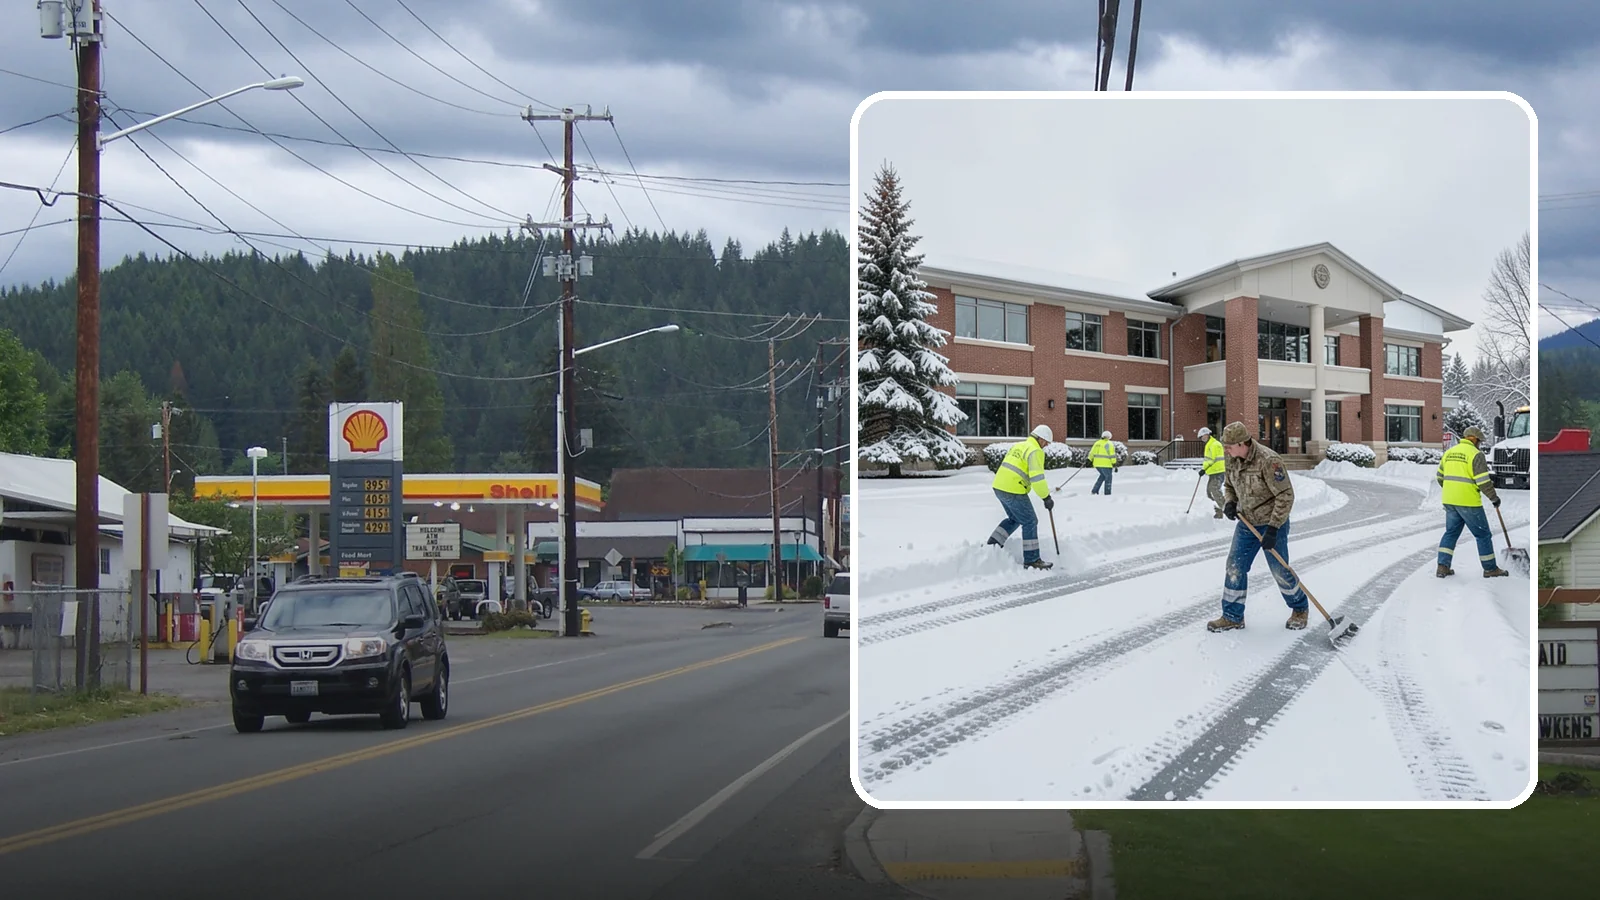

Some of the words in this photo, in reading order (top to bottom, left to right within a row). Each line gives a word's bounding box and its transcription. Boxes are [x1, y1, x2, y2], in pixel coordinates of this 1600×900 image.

[366, 480, 383, 490] 395
[490, 484, 547, 499] Shell
[366, 494, 383, 504] 405
[366, 508, 383, 518] 415
[366, 522, 383, 532] 429
